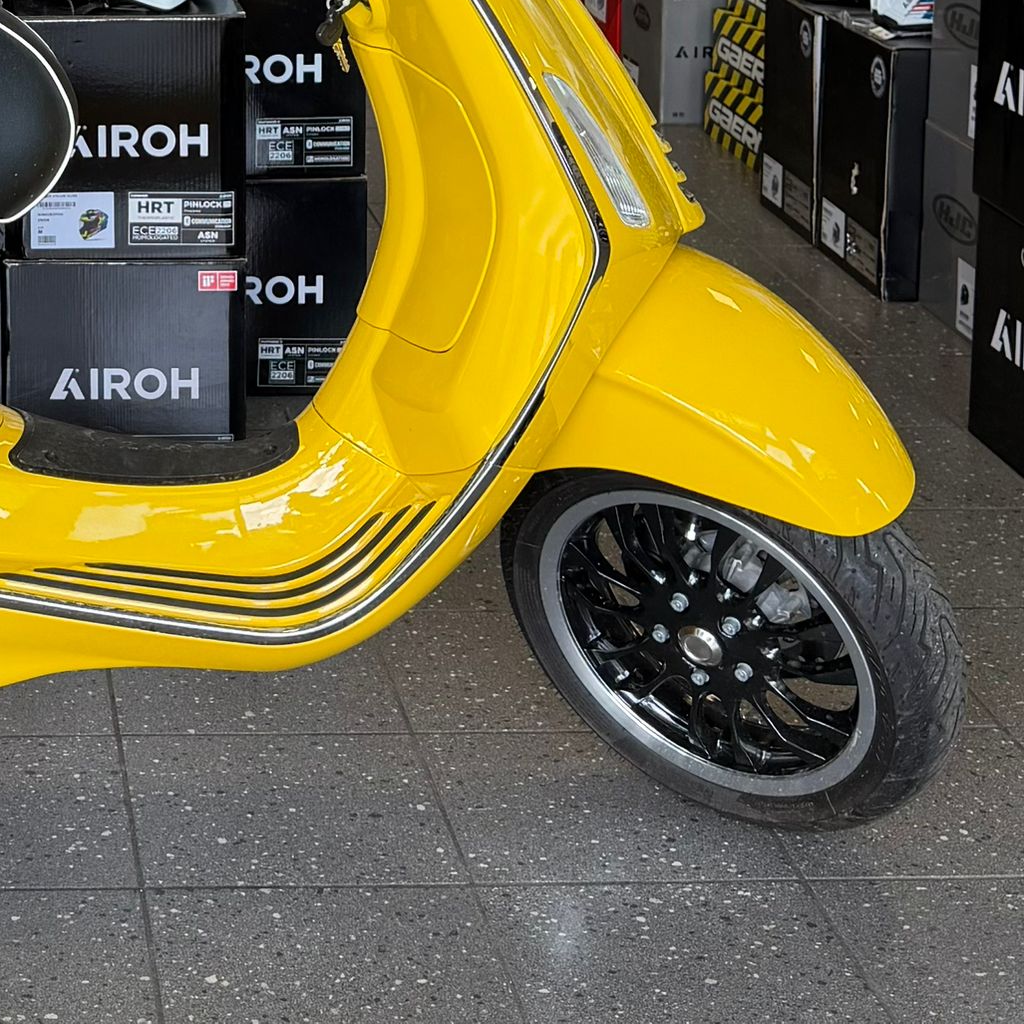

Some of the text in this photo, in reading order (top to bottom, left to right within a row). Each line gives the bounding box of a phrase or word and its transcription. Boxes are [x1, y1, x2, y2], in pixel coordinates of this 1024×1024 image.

[282, 126, 303, 134] ASN
[269, 141, 293, 151] ECE
[137, 201, 175, 213] HRT
[183, 201, 222, 209] PINLOCK
[132, 226, 156, 235] ECE
[197, 231, 218, 240] ASN
[284, 347, 305, 355] ASN
[271, 361, 294, 370] ECE
[49, 367, 200, 400] AIROH
